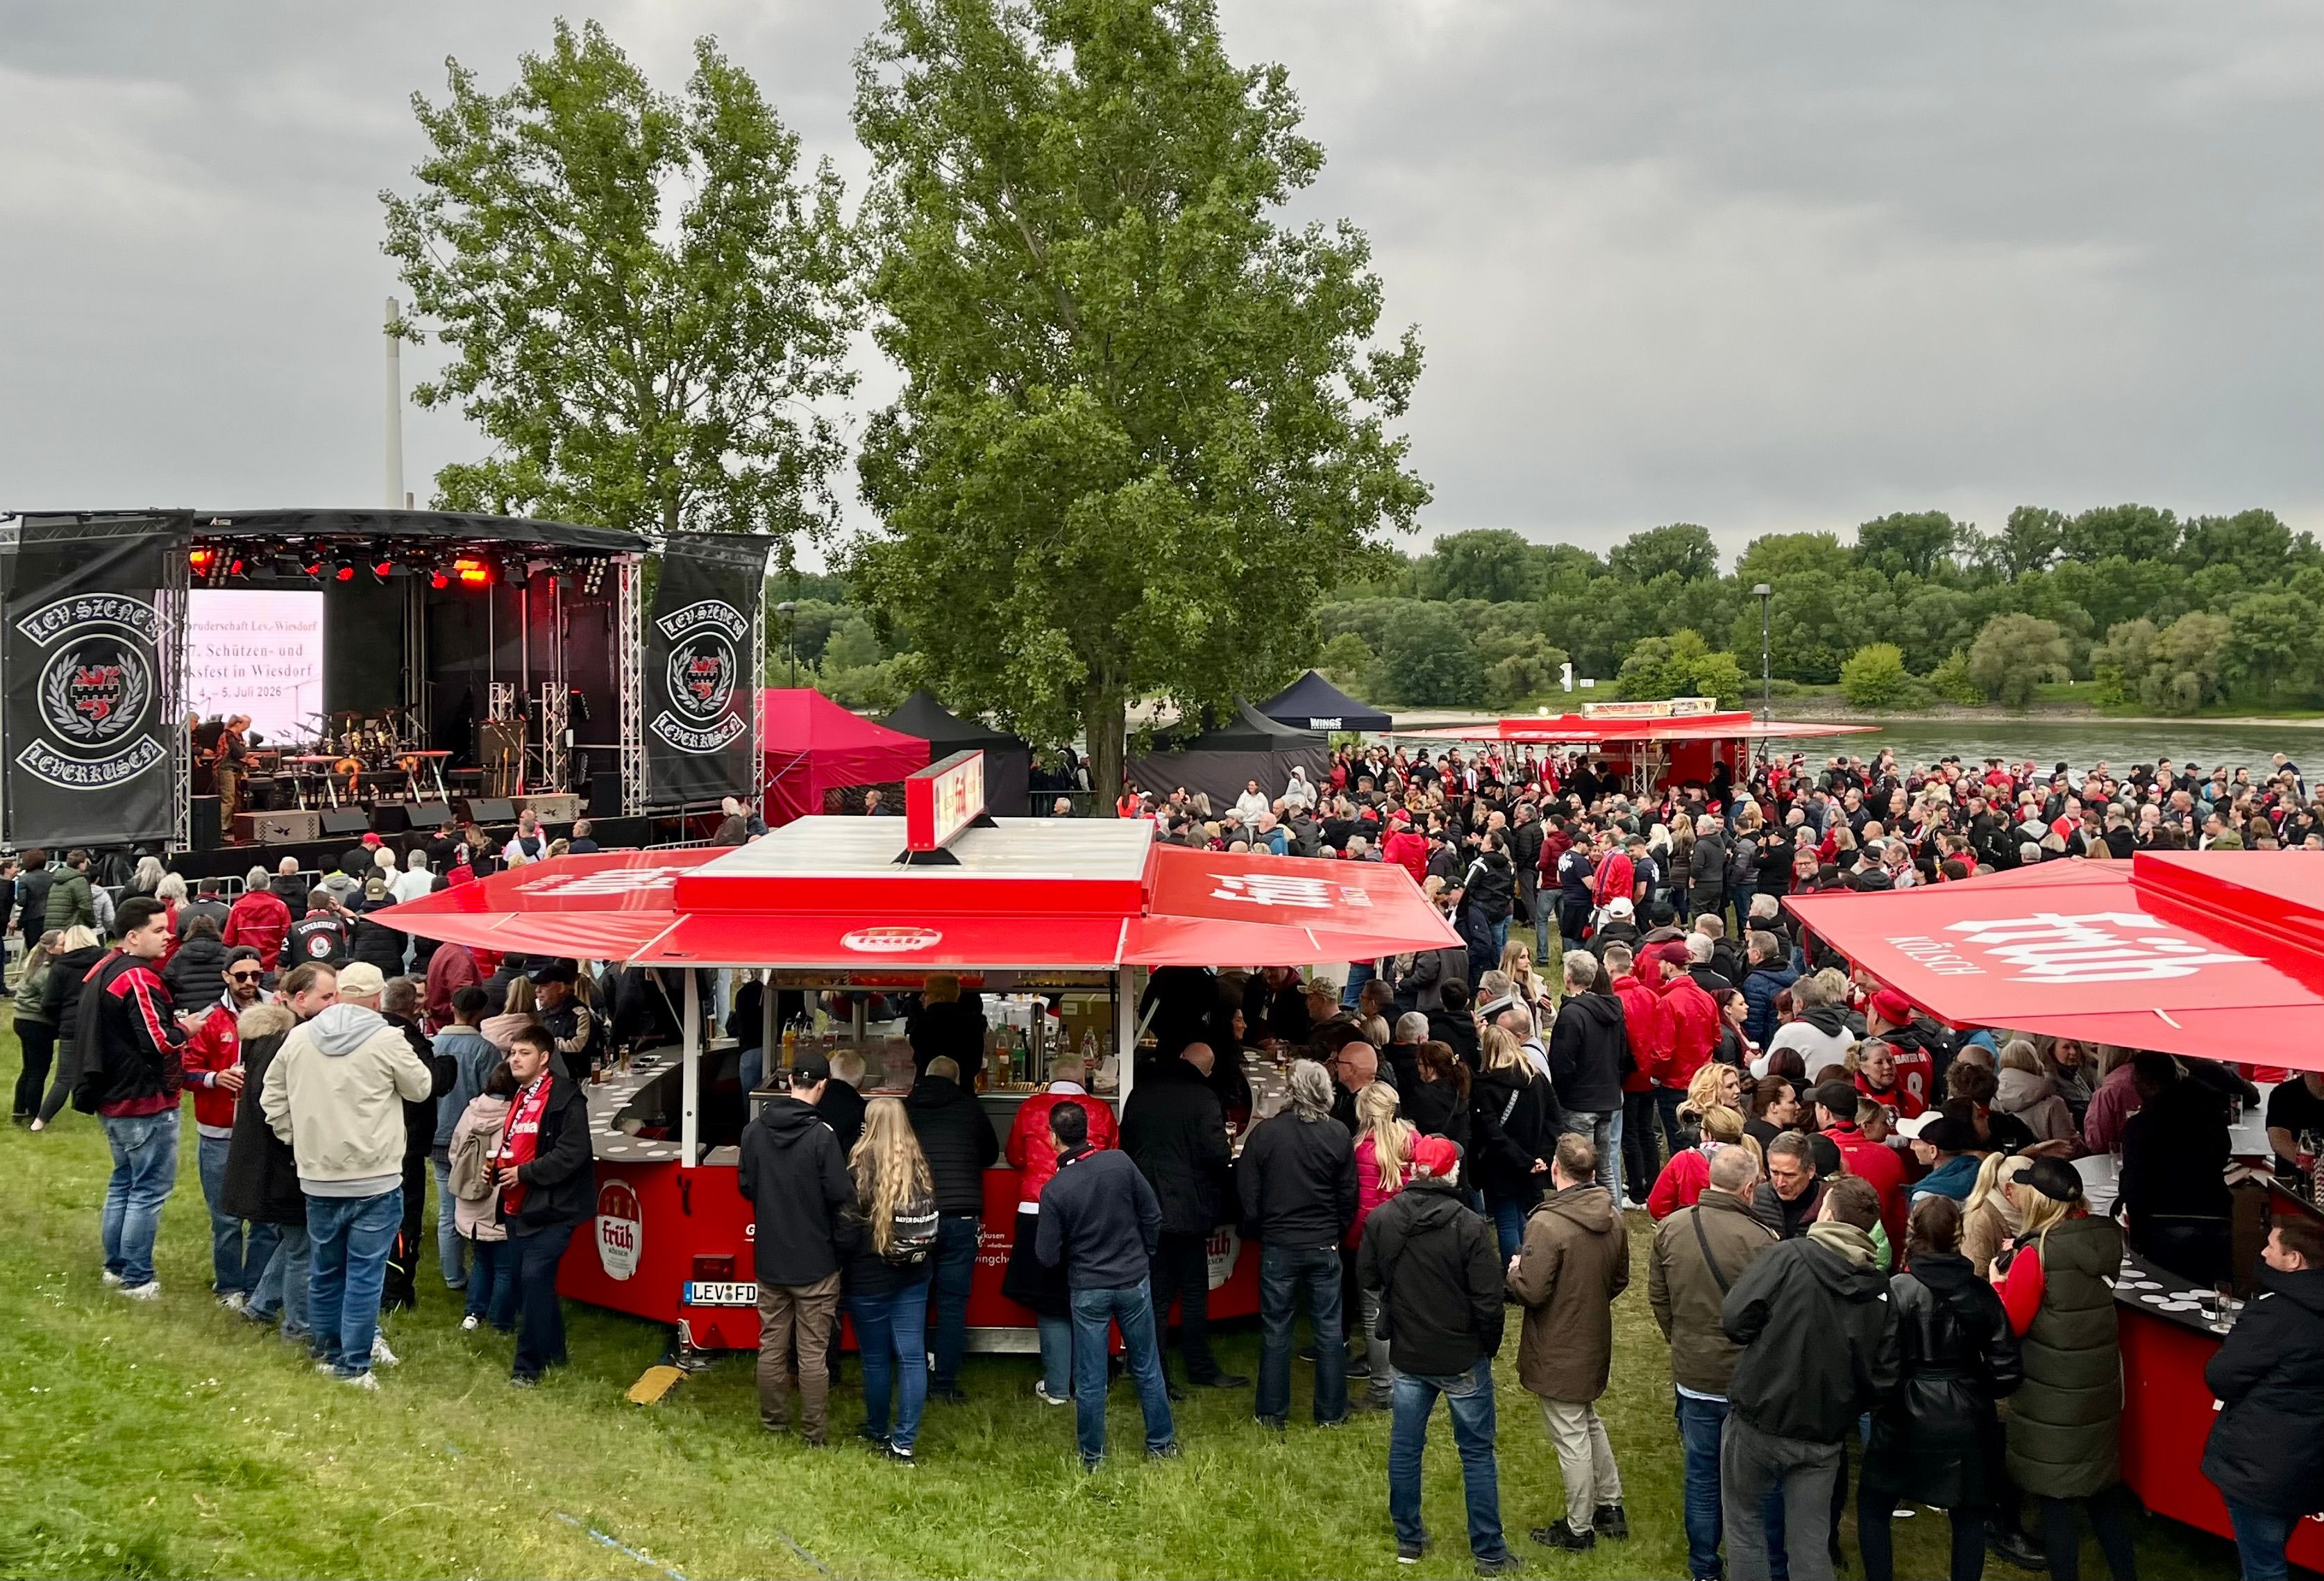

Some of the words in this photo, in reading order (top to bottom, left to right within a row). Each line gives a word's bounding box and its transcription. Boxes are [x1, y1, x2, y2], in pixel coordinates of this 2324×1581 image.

[206, 643, 274, 657] Schützen-
[278, 644, 303, 657] und
[233, 664, 246, 678] in
[251, 664, 314, 678] Wiesdorf
[235, 687, 254, 698] Juli
[257, 686, 282, 698] 2026
[1309, 717, 1342, 726] WINGS
[657, 715, 741, 748] LEVERKUSEN
[25, 741, 158, 783] LEVERKUSEN
[1884, 935, 1987, 976] KÖLSCH
[1894, 1053, 1919, 1064] BAYER
[693, 1285, 725, 1300] LEV
